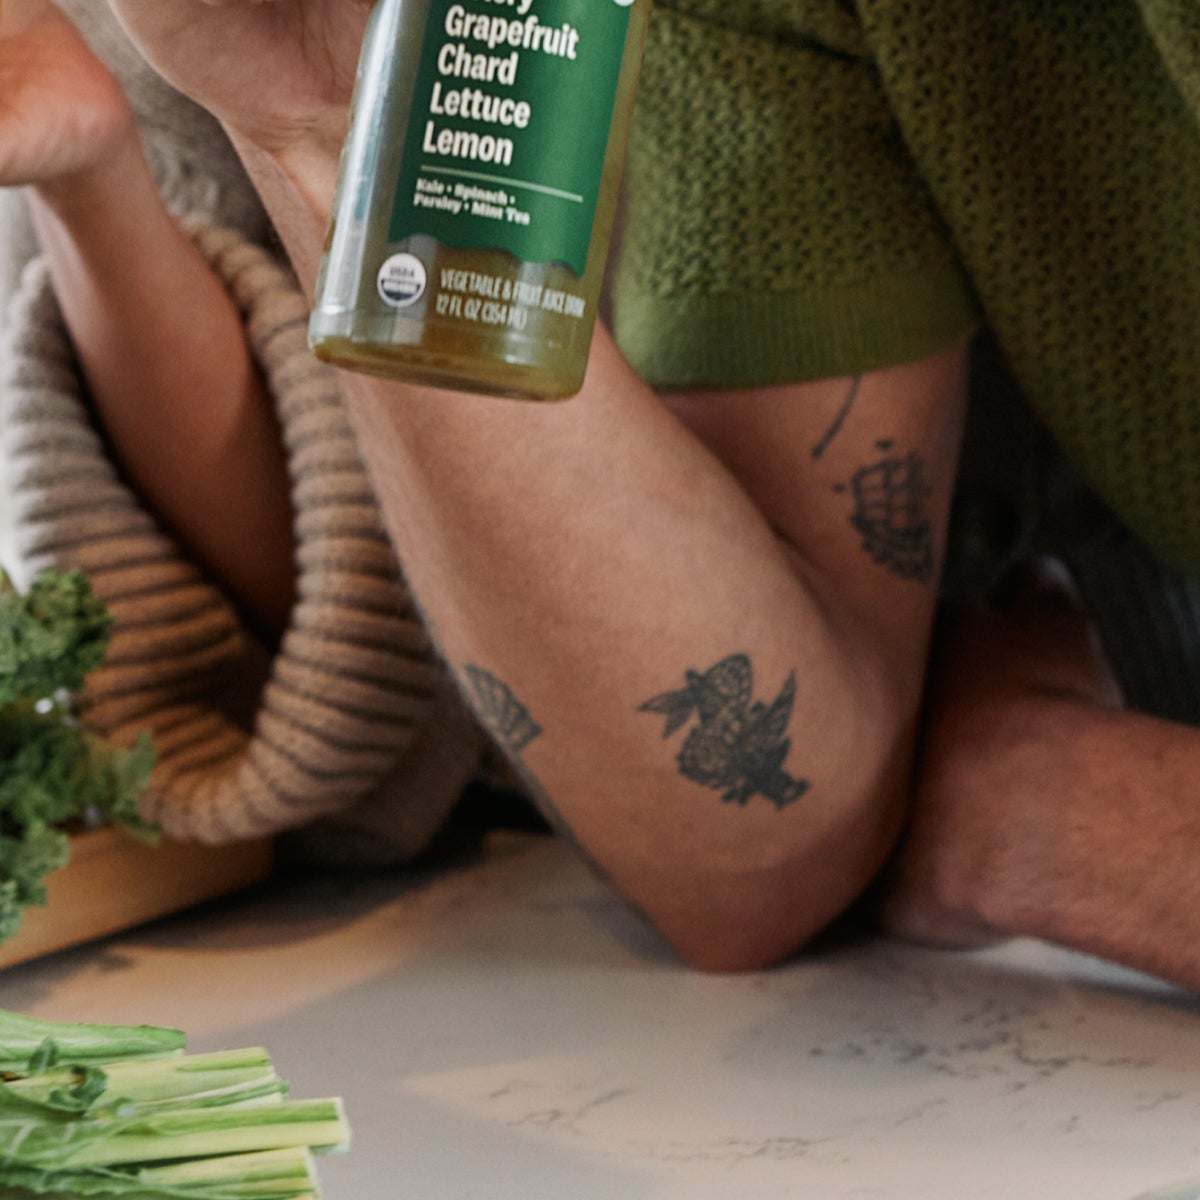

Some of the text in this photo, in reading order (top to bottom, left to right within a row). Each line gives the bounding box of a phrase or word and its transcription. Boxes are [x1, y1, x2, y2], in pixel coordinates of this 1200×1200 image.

[445, 5, 579, 59] Grapefruit
[437, 43, 519, 85] Chard
[430, 81, 531, 128] Lettuce
[422, 120, 514, 166] Lemon
[416, 178, 445, 194] Kale
[413, 192, 462, 215] Parsley
[505, 206, 530, 225] Tea
[441, 268, 502, 299] VEGETABLE
